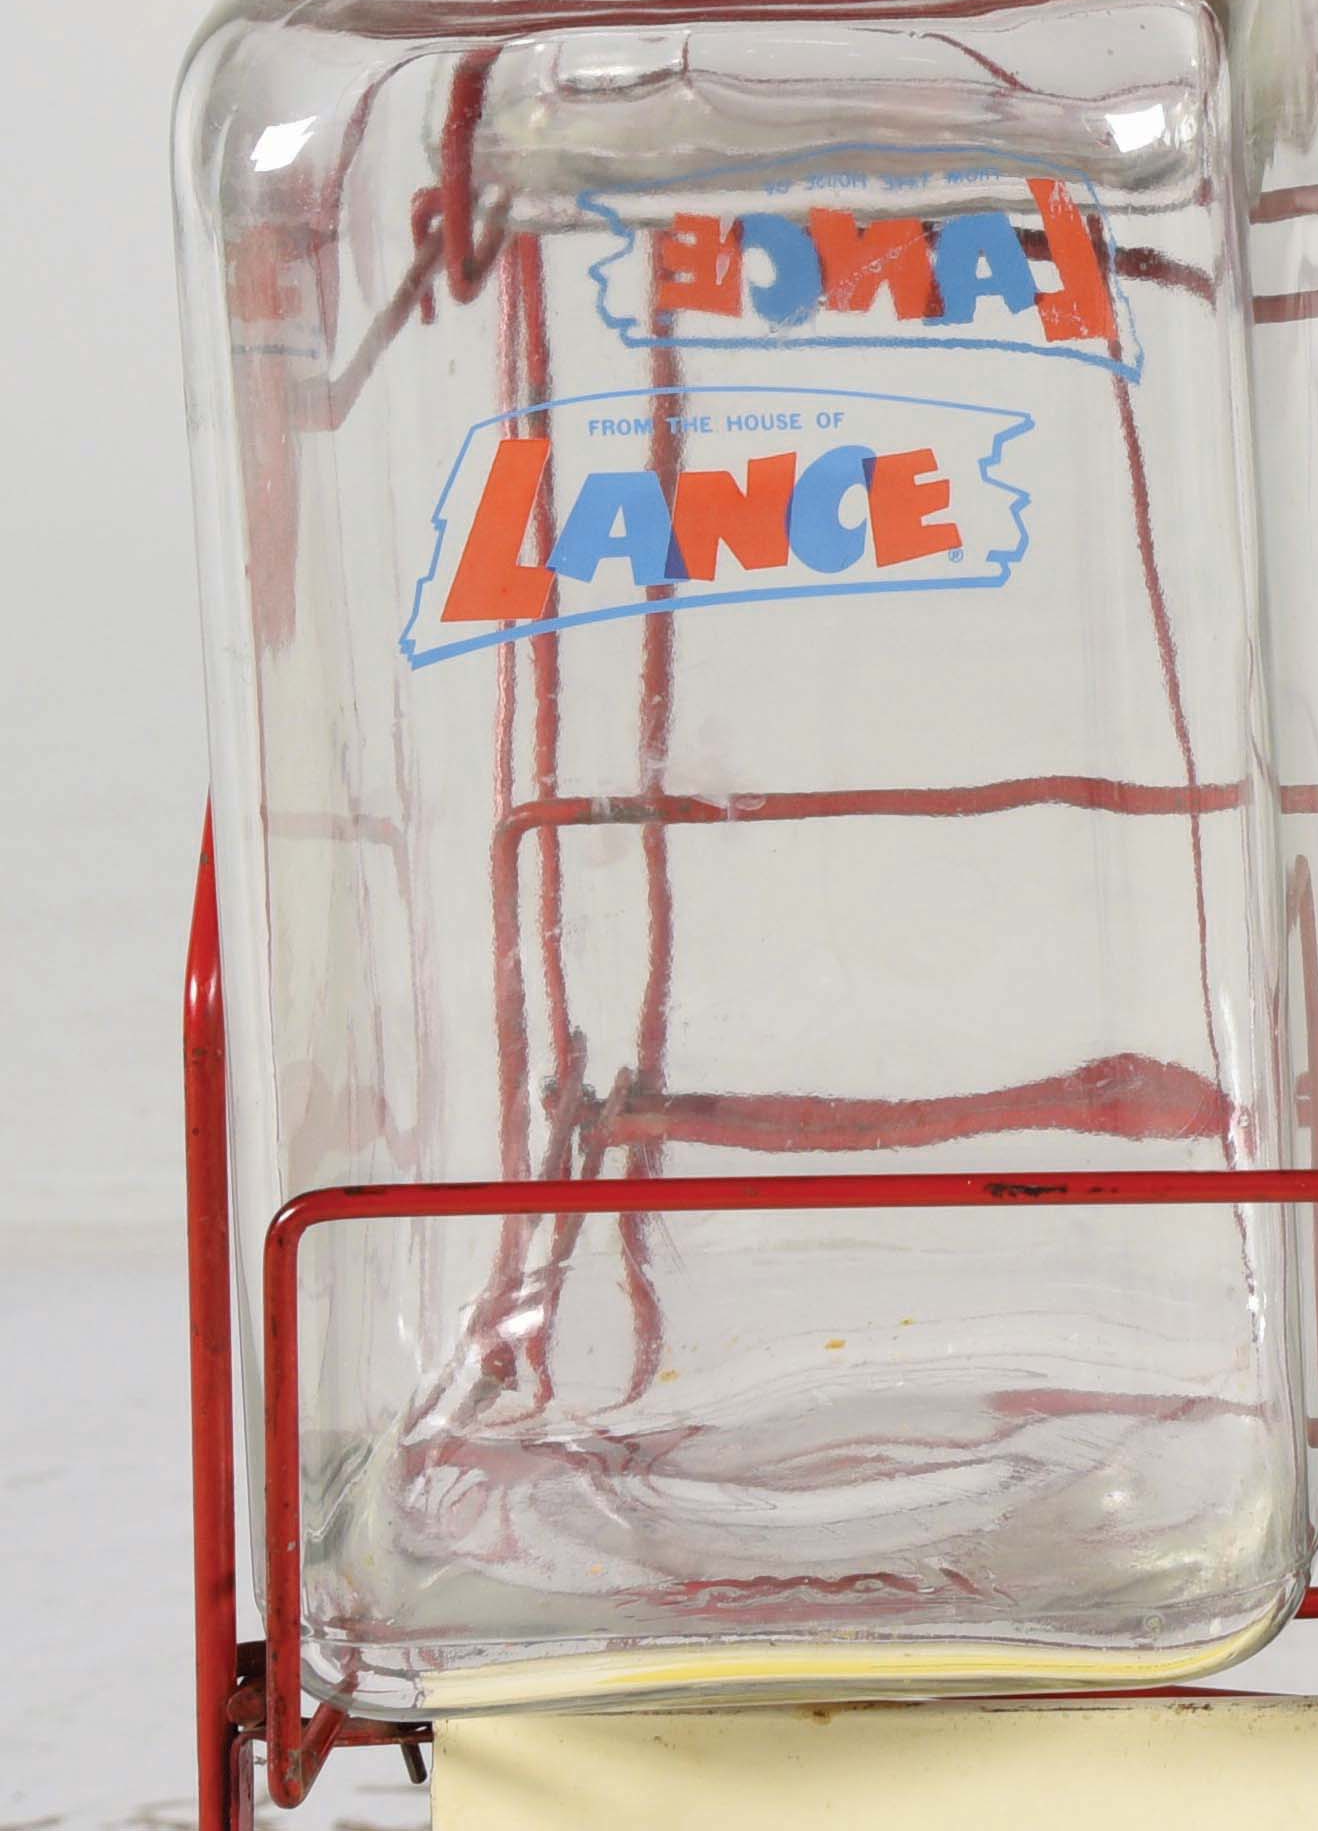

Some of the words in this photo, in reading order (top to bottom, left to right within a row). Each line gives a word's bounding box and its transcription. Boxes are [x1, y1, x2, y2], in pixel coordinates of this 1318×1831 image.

[588, 418, 654, 437] FROM
[665, 416, 712, 436] THE
[726, 413, 804, 433] HOUSE
[816, 411, 846, 431] OF
[440, 438, 963, 623] LANCE
